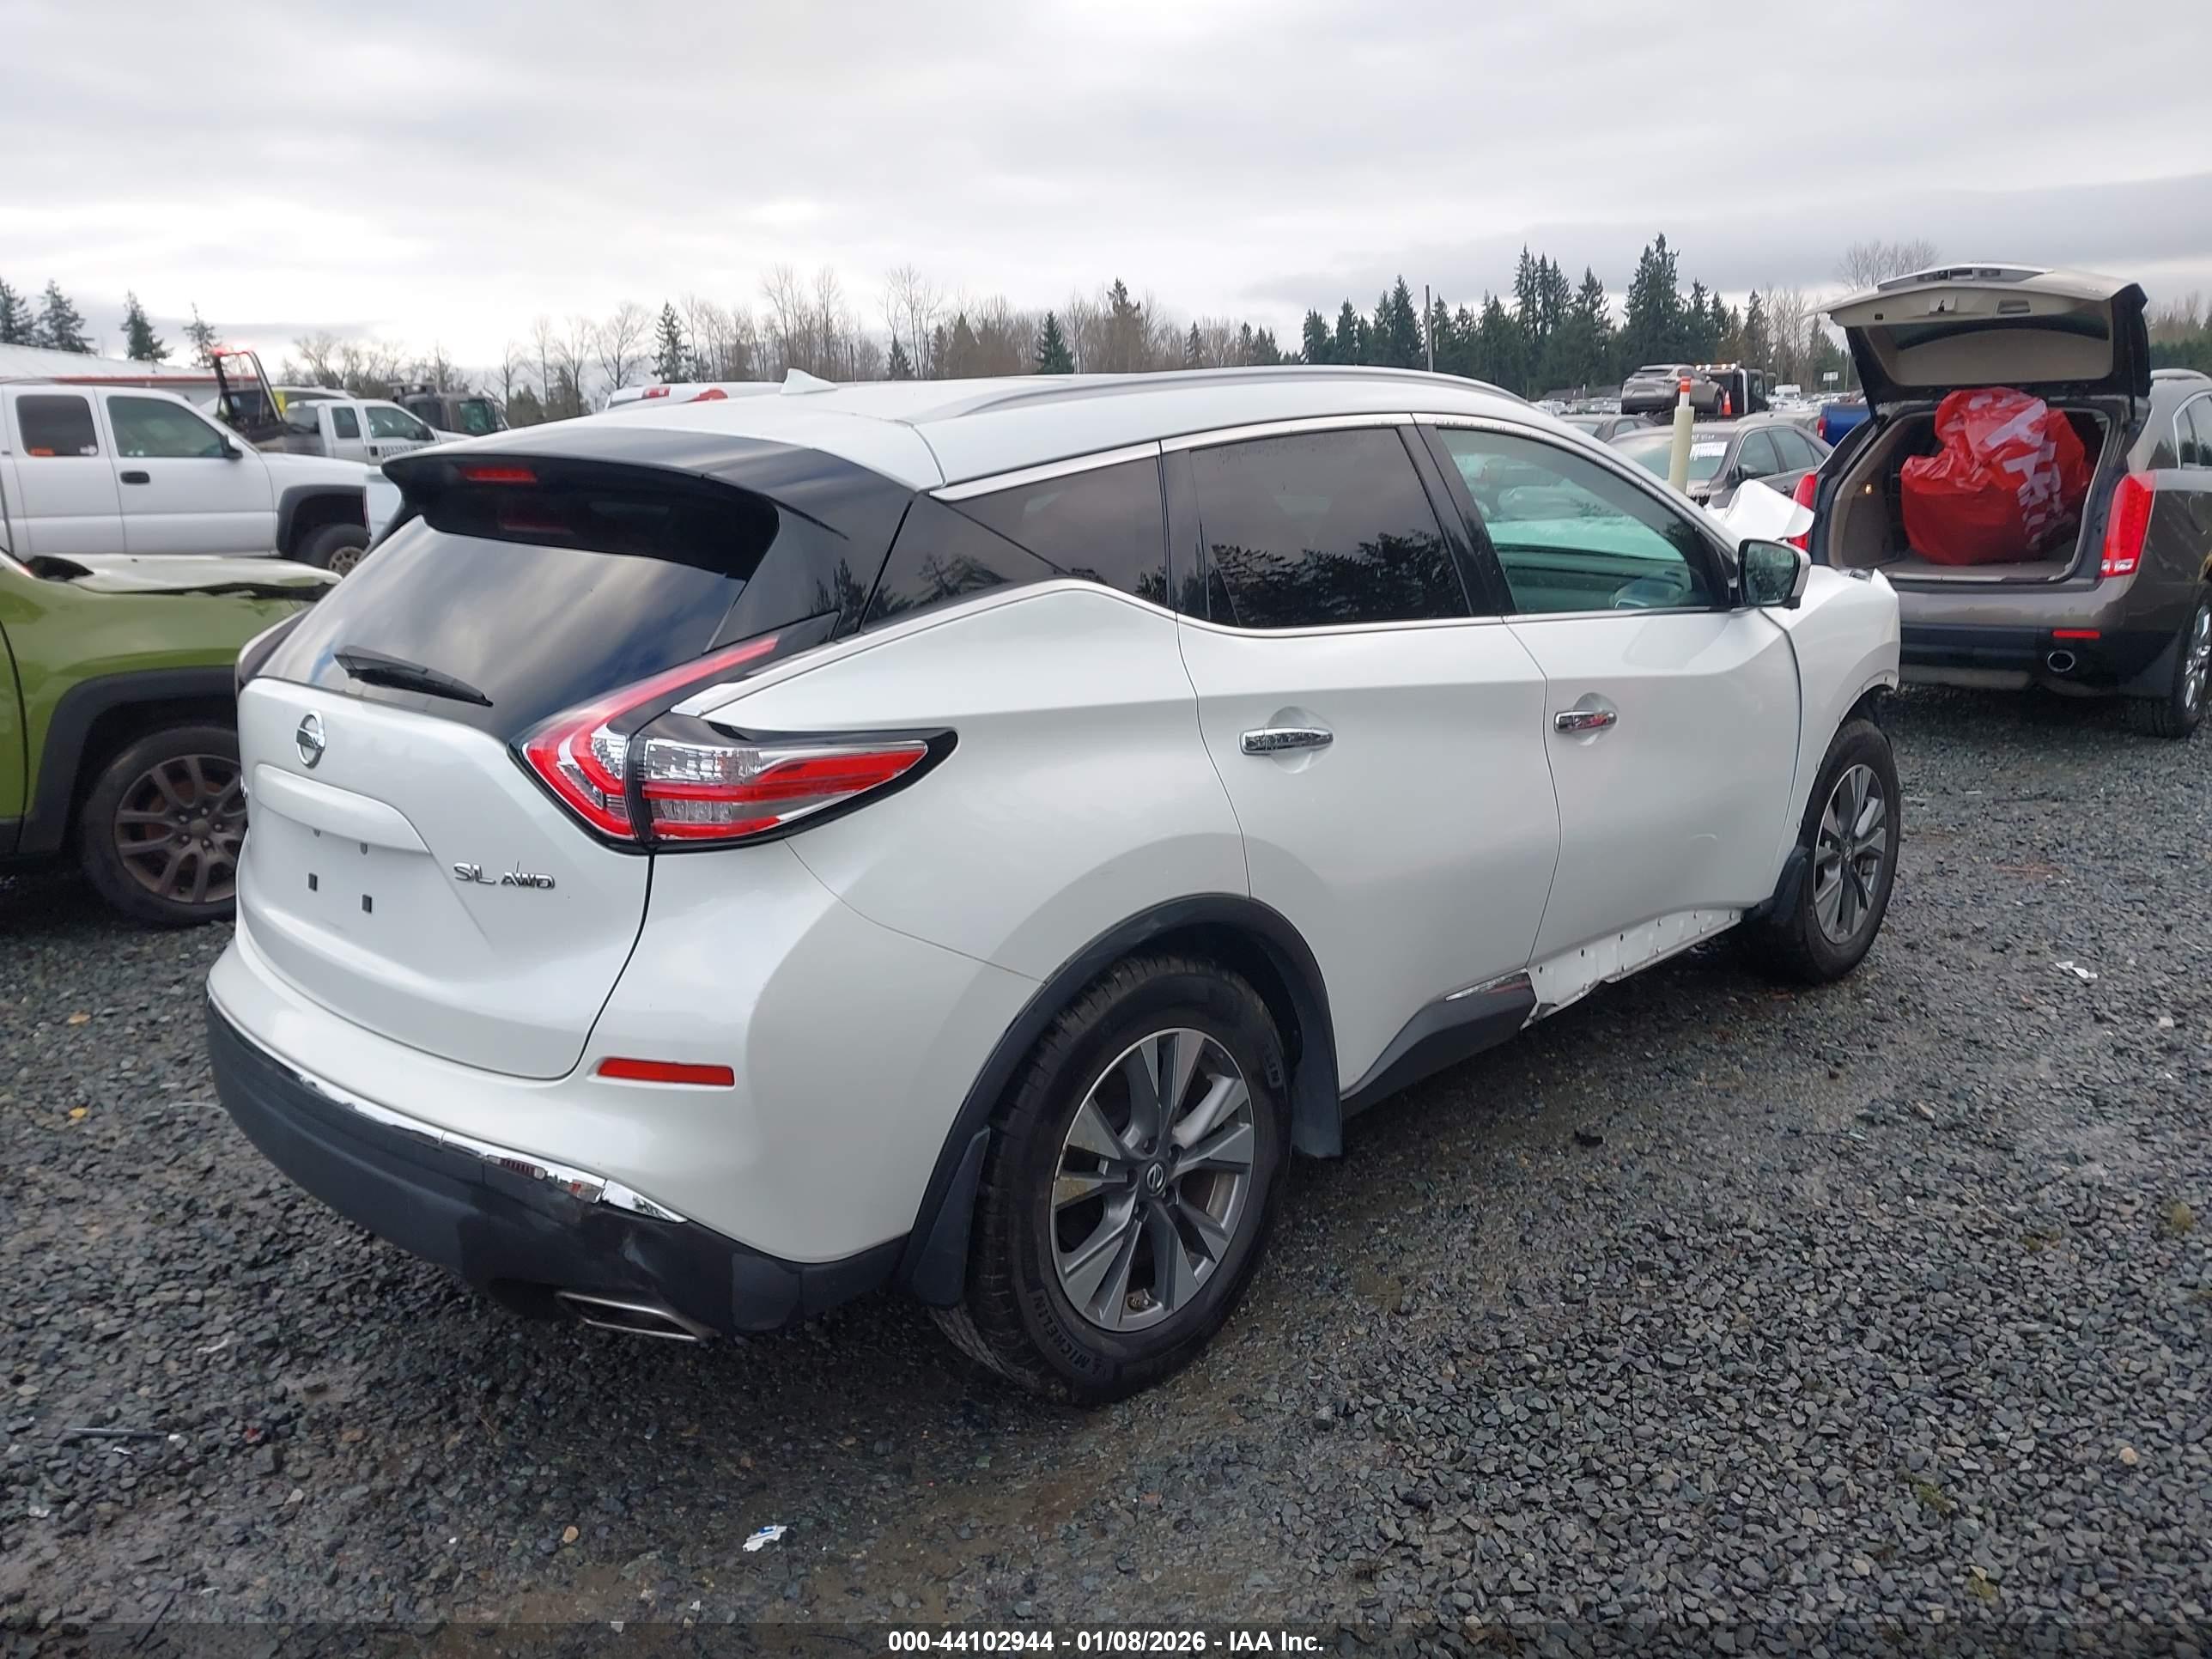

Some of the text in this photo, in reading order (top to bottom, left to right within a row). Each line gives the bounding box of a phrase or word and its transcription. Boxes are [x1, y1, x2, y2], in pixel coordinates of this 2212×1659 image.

[453, 861, 556, 890] SL AWD
[1032, 1296, 1091, 1369] MICHELIN
